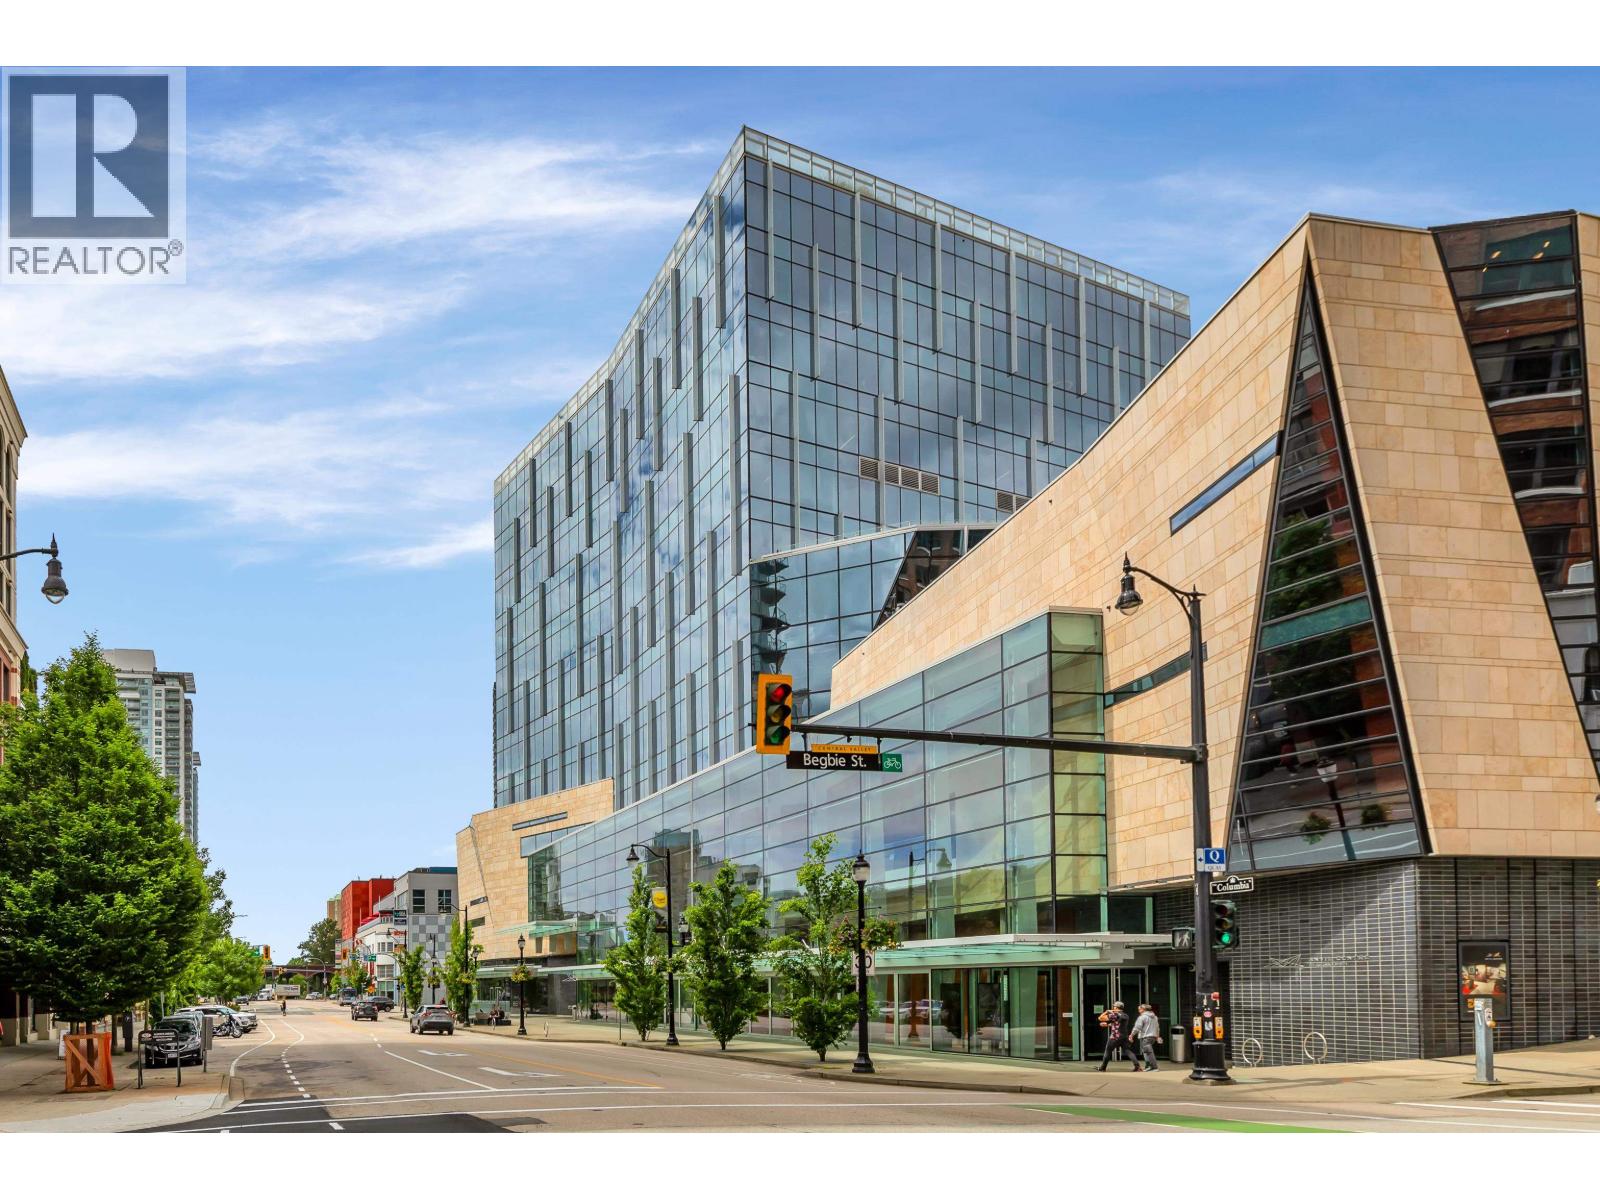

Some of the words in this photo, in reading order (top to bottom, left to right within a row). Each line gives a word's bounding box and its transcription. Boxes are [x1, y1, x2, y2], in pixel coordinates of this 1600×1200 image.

[803, 753, 846, 769] Begbie
[851, 754, 867, 767] St.
[1210, 850, 1220, 862] Q
[1216, 880, 1250, 892] Columbia
